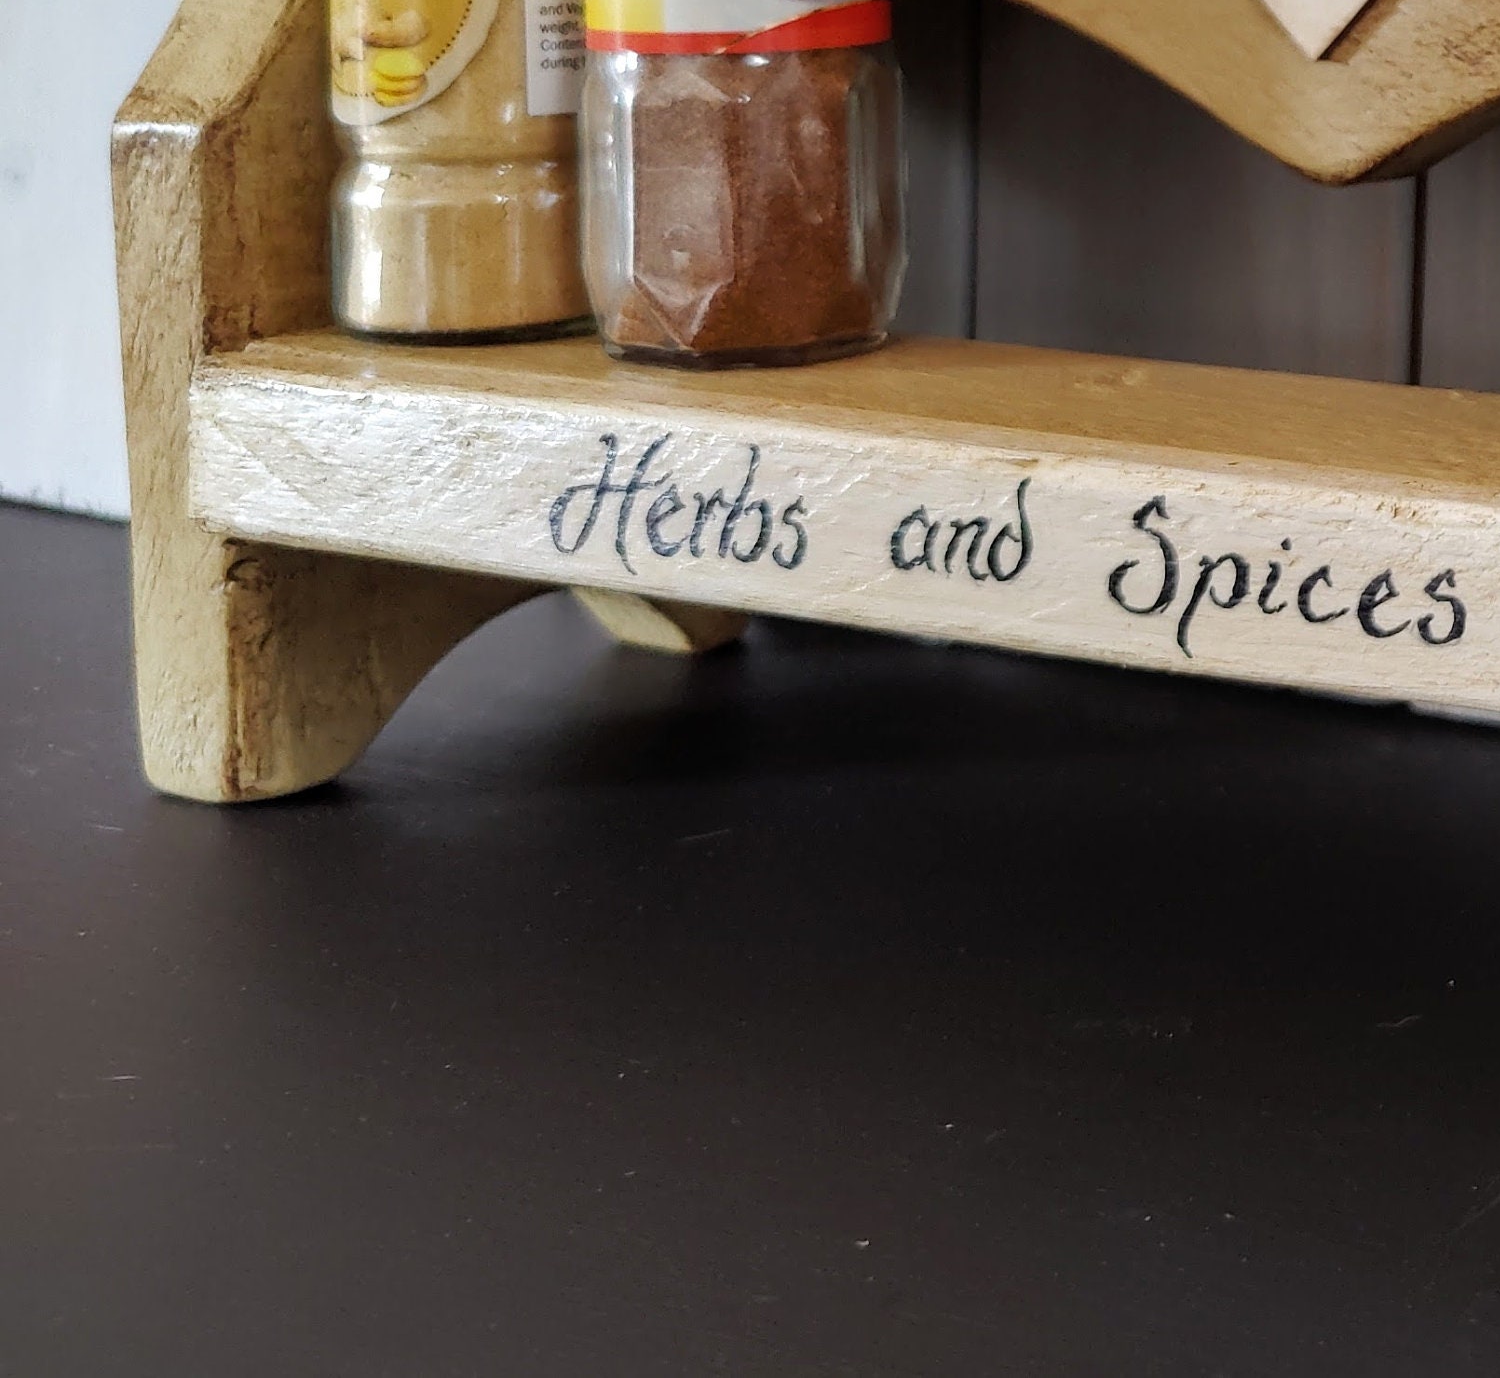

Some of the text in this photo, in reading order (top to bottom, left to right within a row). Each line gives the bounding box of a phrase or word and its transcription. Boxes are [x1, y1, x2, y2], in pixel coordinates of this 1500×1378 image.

[540, 3, 563, 16] and
[549, 431, 1468, 659] Herbs and Spices
